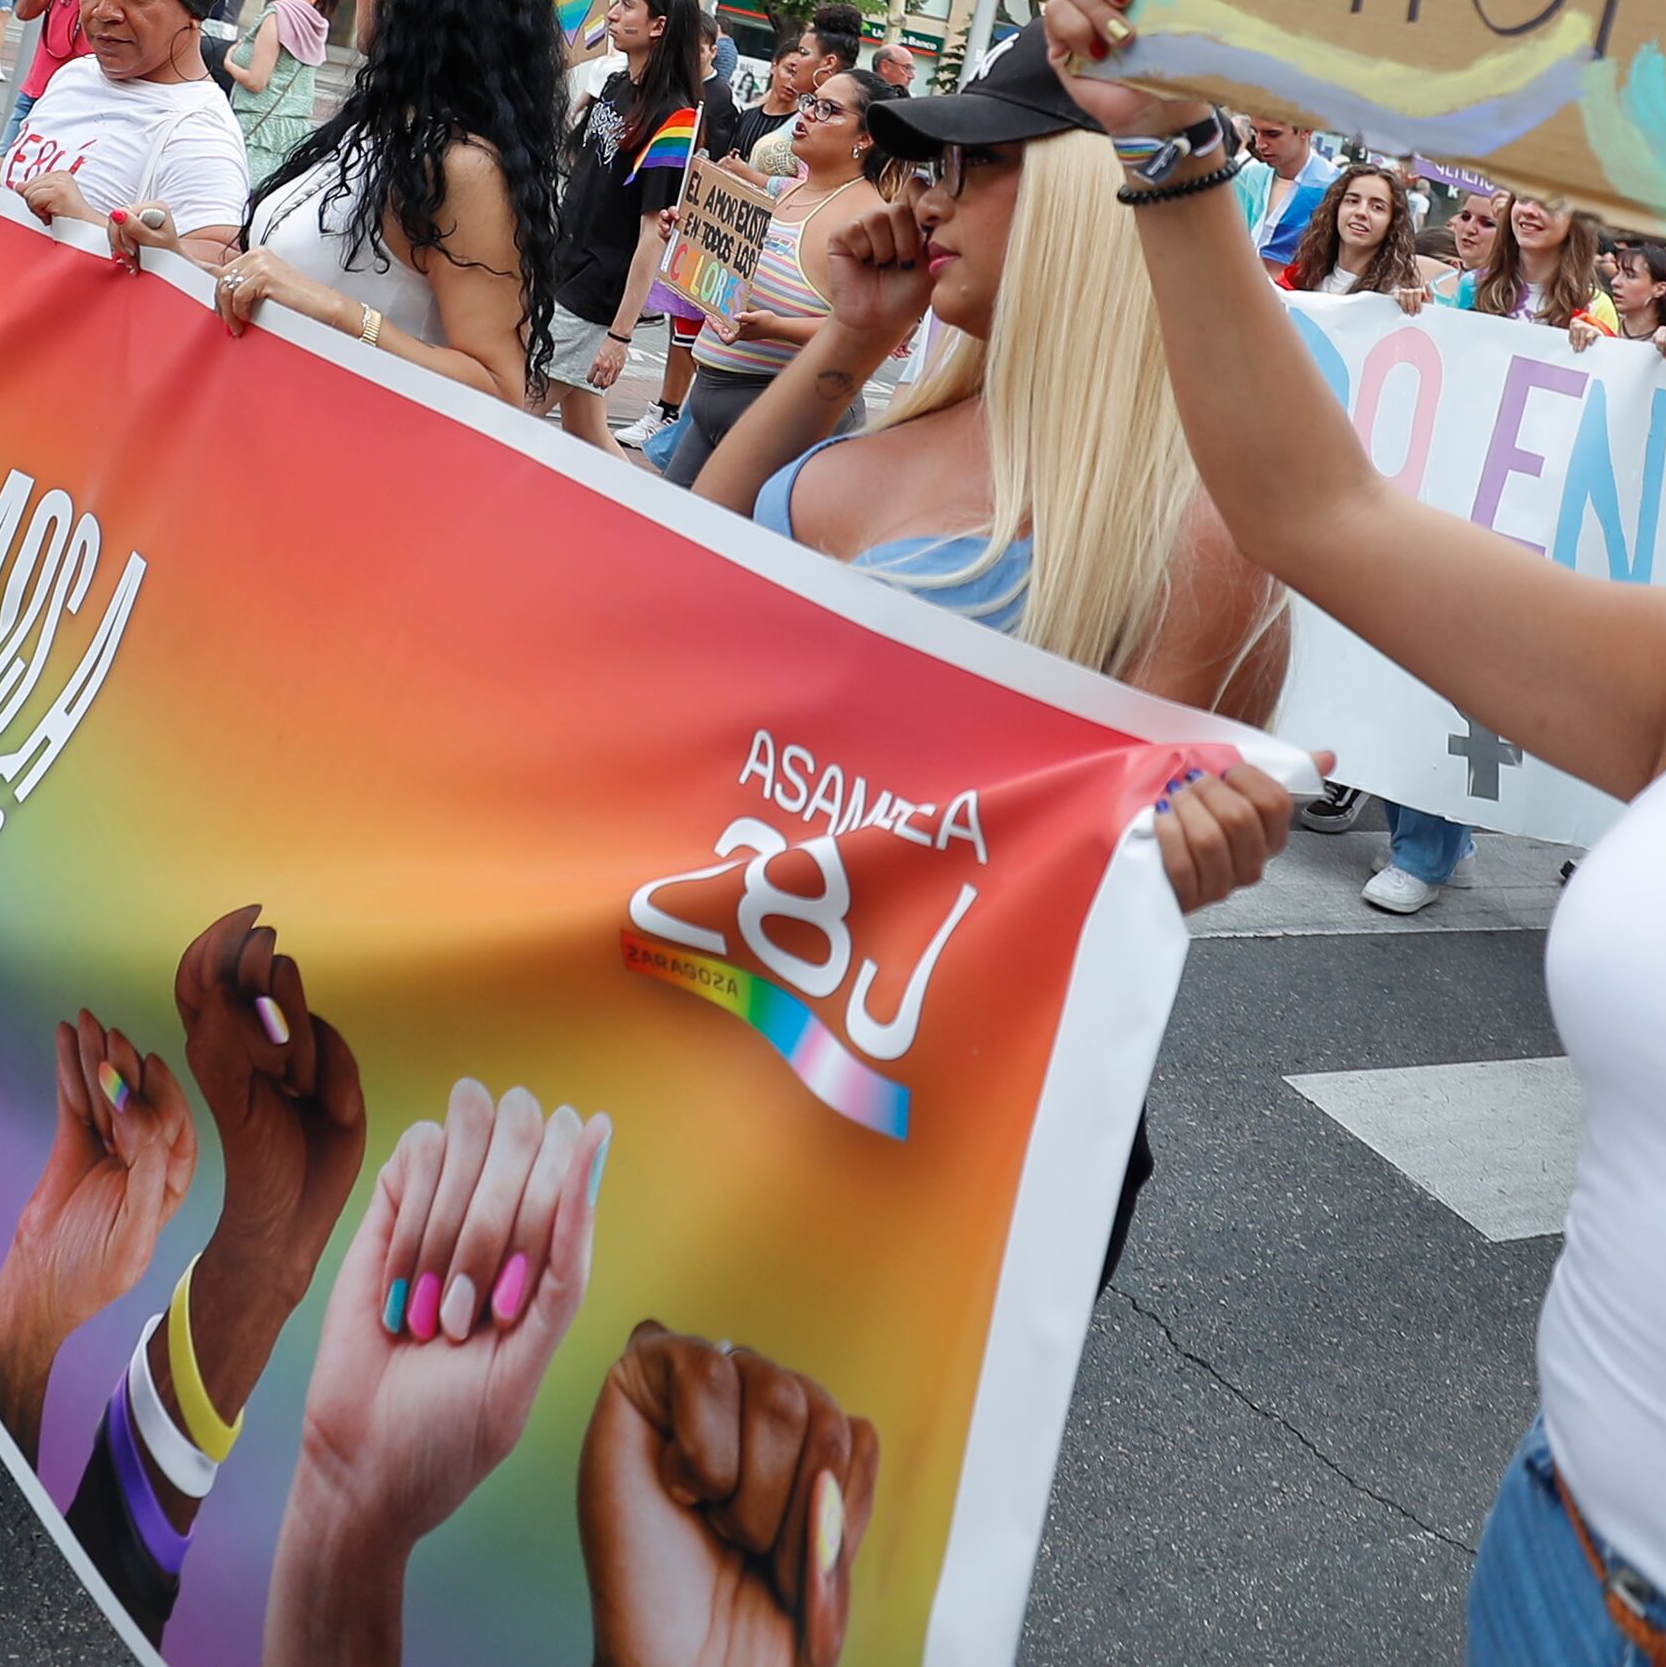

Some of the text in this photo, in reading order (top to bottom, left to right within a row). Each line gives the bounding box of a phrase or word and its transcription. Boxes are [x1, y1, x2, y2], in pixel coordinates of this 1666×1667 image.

[908, 36, 937, 50] Banco
[683, 211, 702, 240] EN
[701, 221, 735, 265] TODOS
[685, 171, 772, 251] EL AMOR EXISTE
[670, 243, 746, 324] COLORES
[626, 943, 738, 998] ZARAGOZA
[629, 816, 979, 1061] 28J
